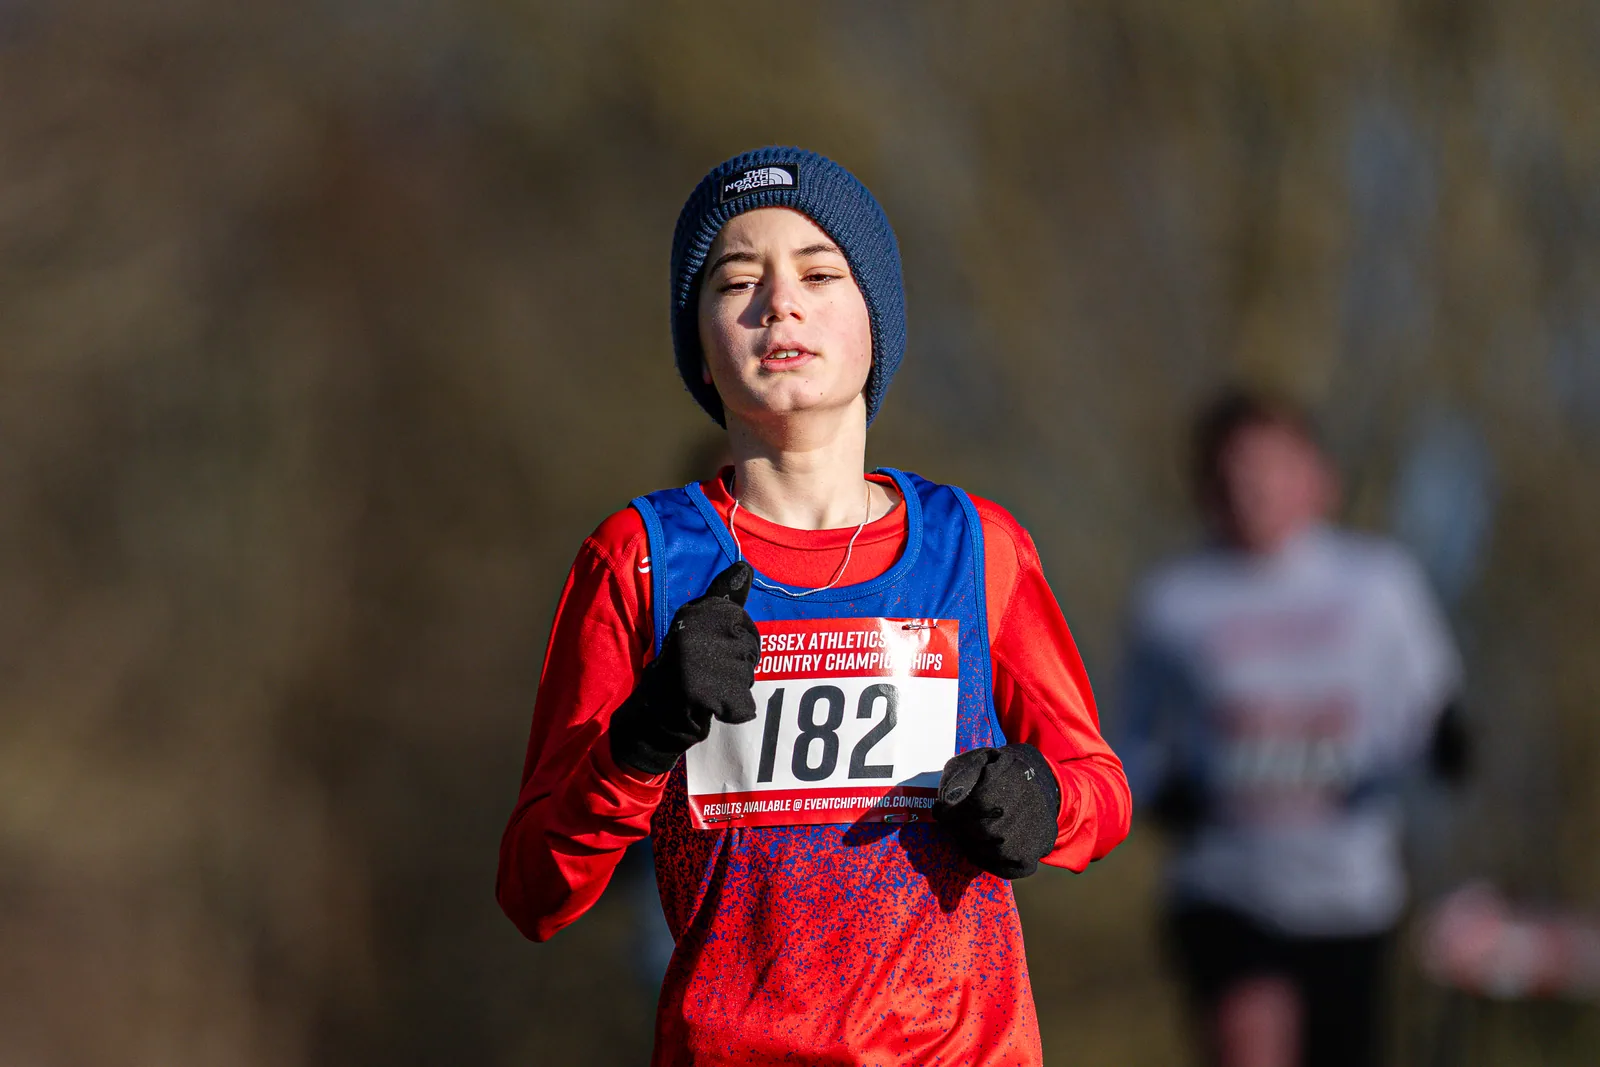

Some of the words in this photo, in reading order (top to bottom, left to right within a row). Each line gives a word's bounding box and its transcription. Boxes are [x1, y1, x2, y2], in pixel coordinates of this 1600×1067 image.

[744, 168, 769, 178] THE
[725, 173, 769, 192] NORTH
[737, 180, 769, 193] FACE
[760, 633, 806, 652] ESSEX
[808, 631, 886, 650] ATHLETICS
[756, 683, 901, 783] 182
[703, 802, 742, 816] RESULTS
[743, 799, 791, 814] AVAILABLE
[793, 799, 803, 812] @
